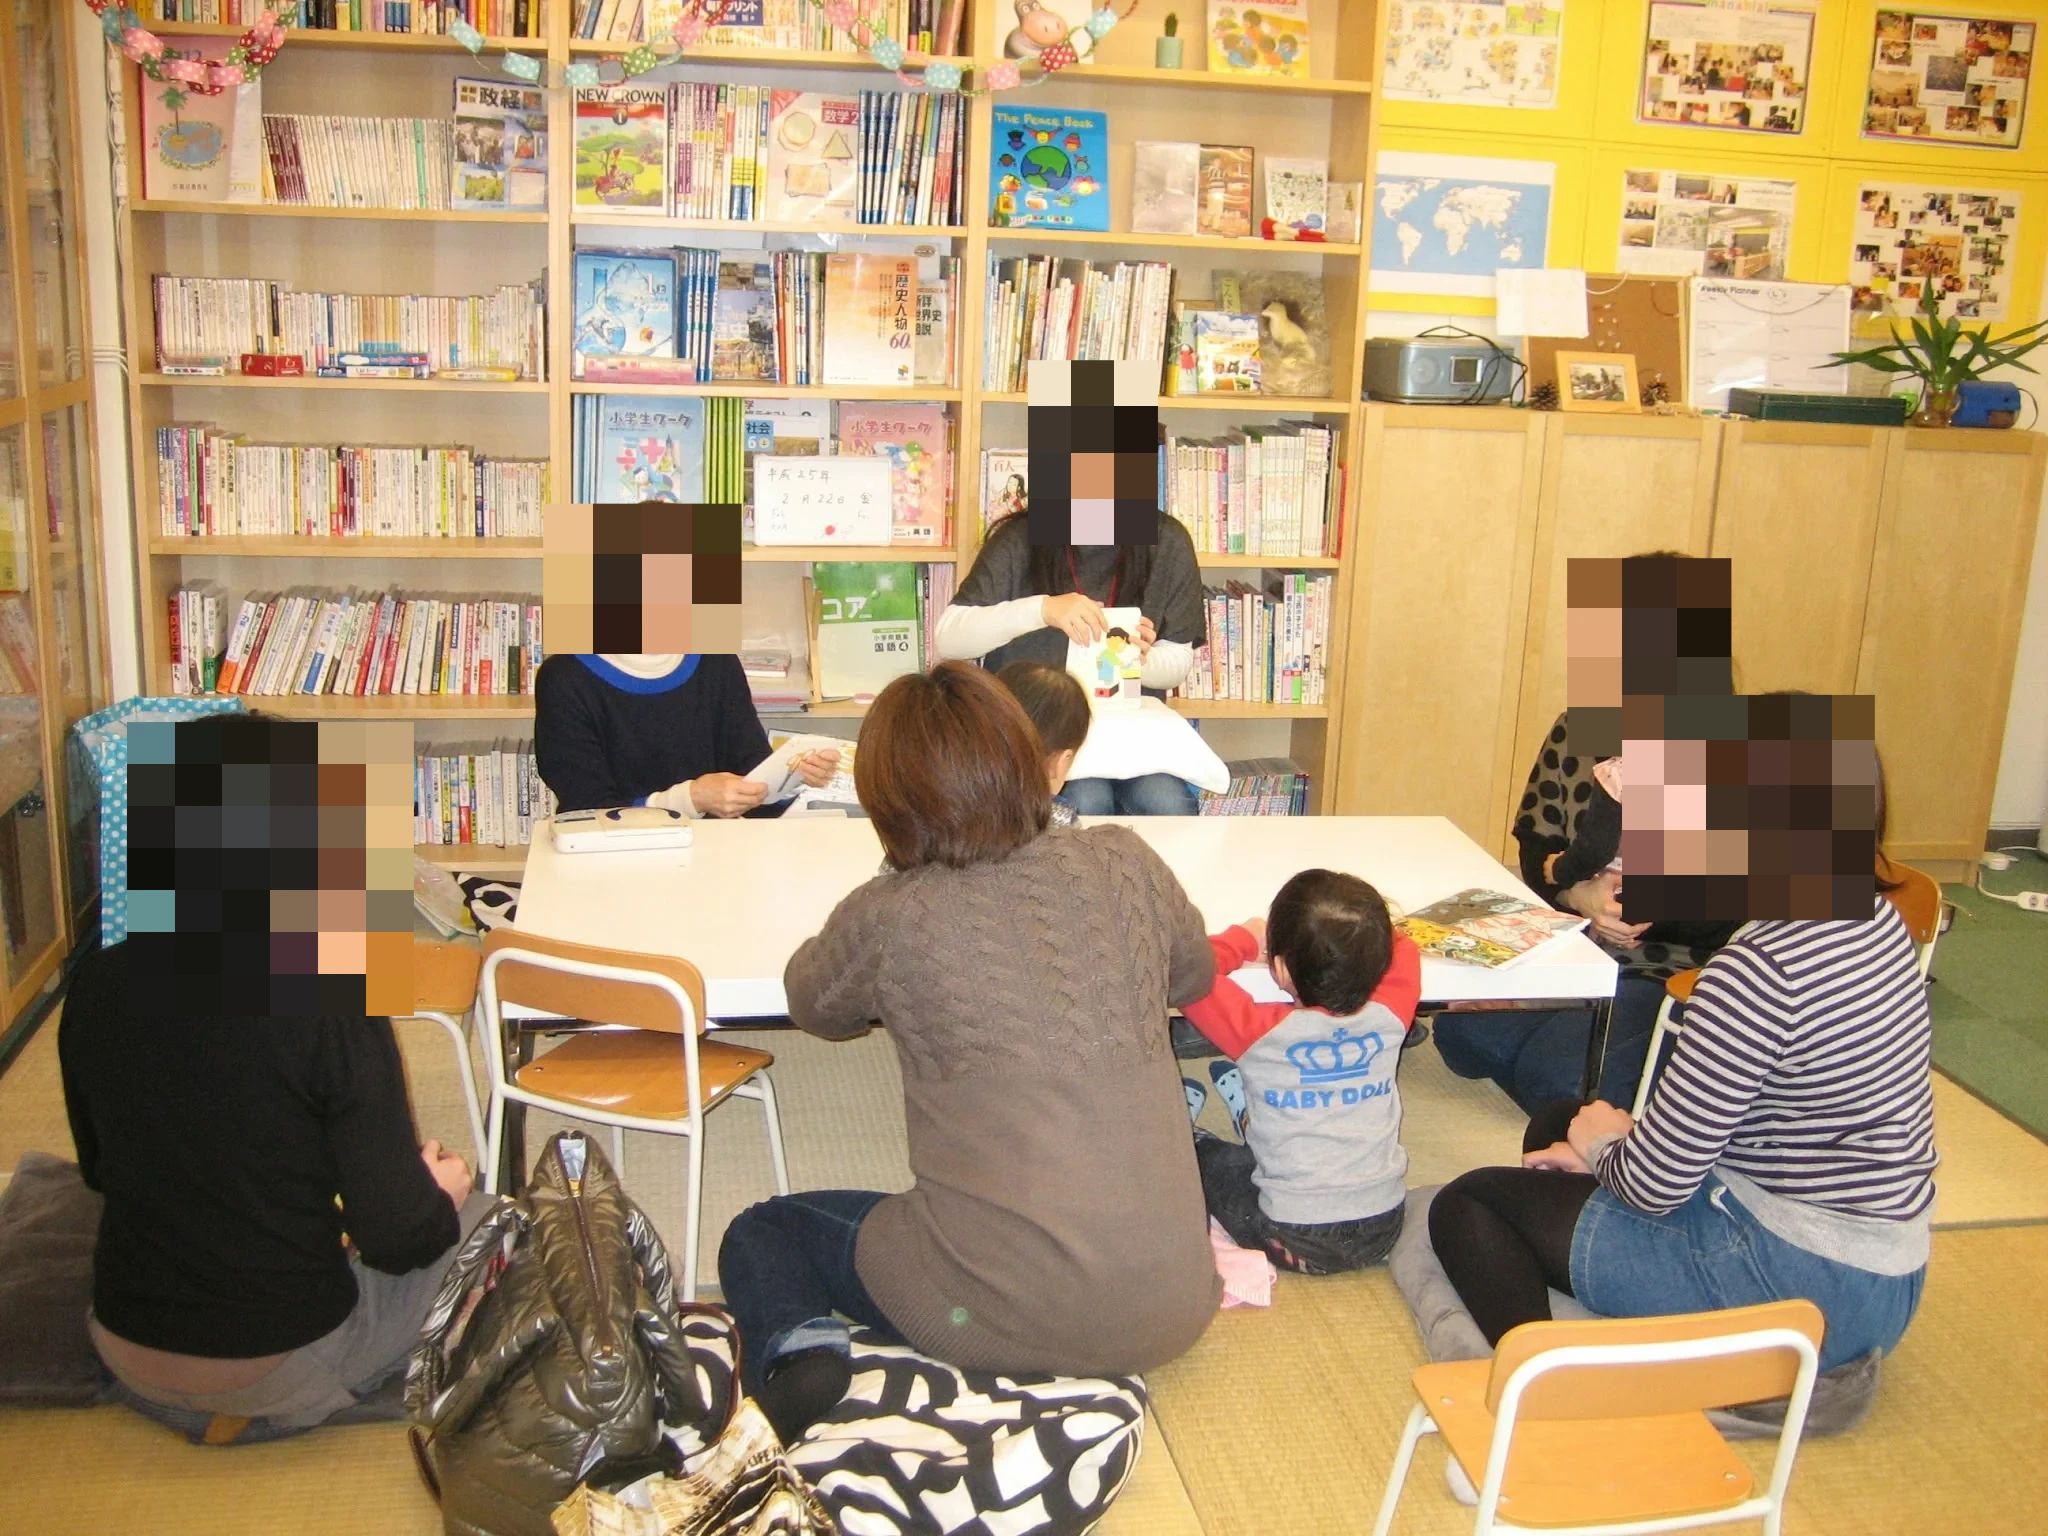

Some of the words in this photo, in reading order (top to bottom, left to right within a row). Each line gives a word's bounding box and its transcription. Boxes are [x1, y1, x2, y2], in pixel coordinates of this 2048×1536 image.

[480, 87, 520, 109] 政経
[576, 88, 609, 101] NEW
[995, 112, 1020, 124] The
[1063, 116, 1095, 129] Book
[1730, 286, 1760, 295] Planner
[895, 274, 909, 331] 歴史人物
[609, 411, 693, 428] 小学生ワーク
[746, 421, 770, 435] 社会
[851, 420, 932, 437] 小学生ワーク
[823, 597, 873, 619] コア
[1264, 1088, 1335, 1109] BABY
[1341, 1078, 1391, 1106] DOLL
